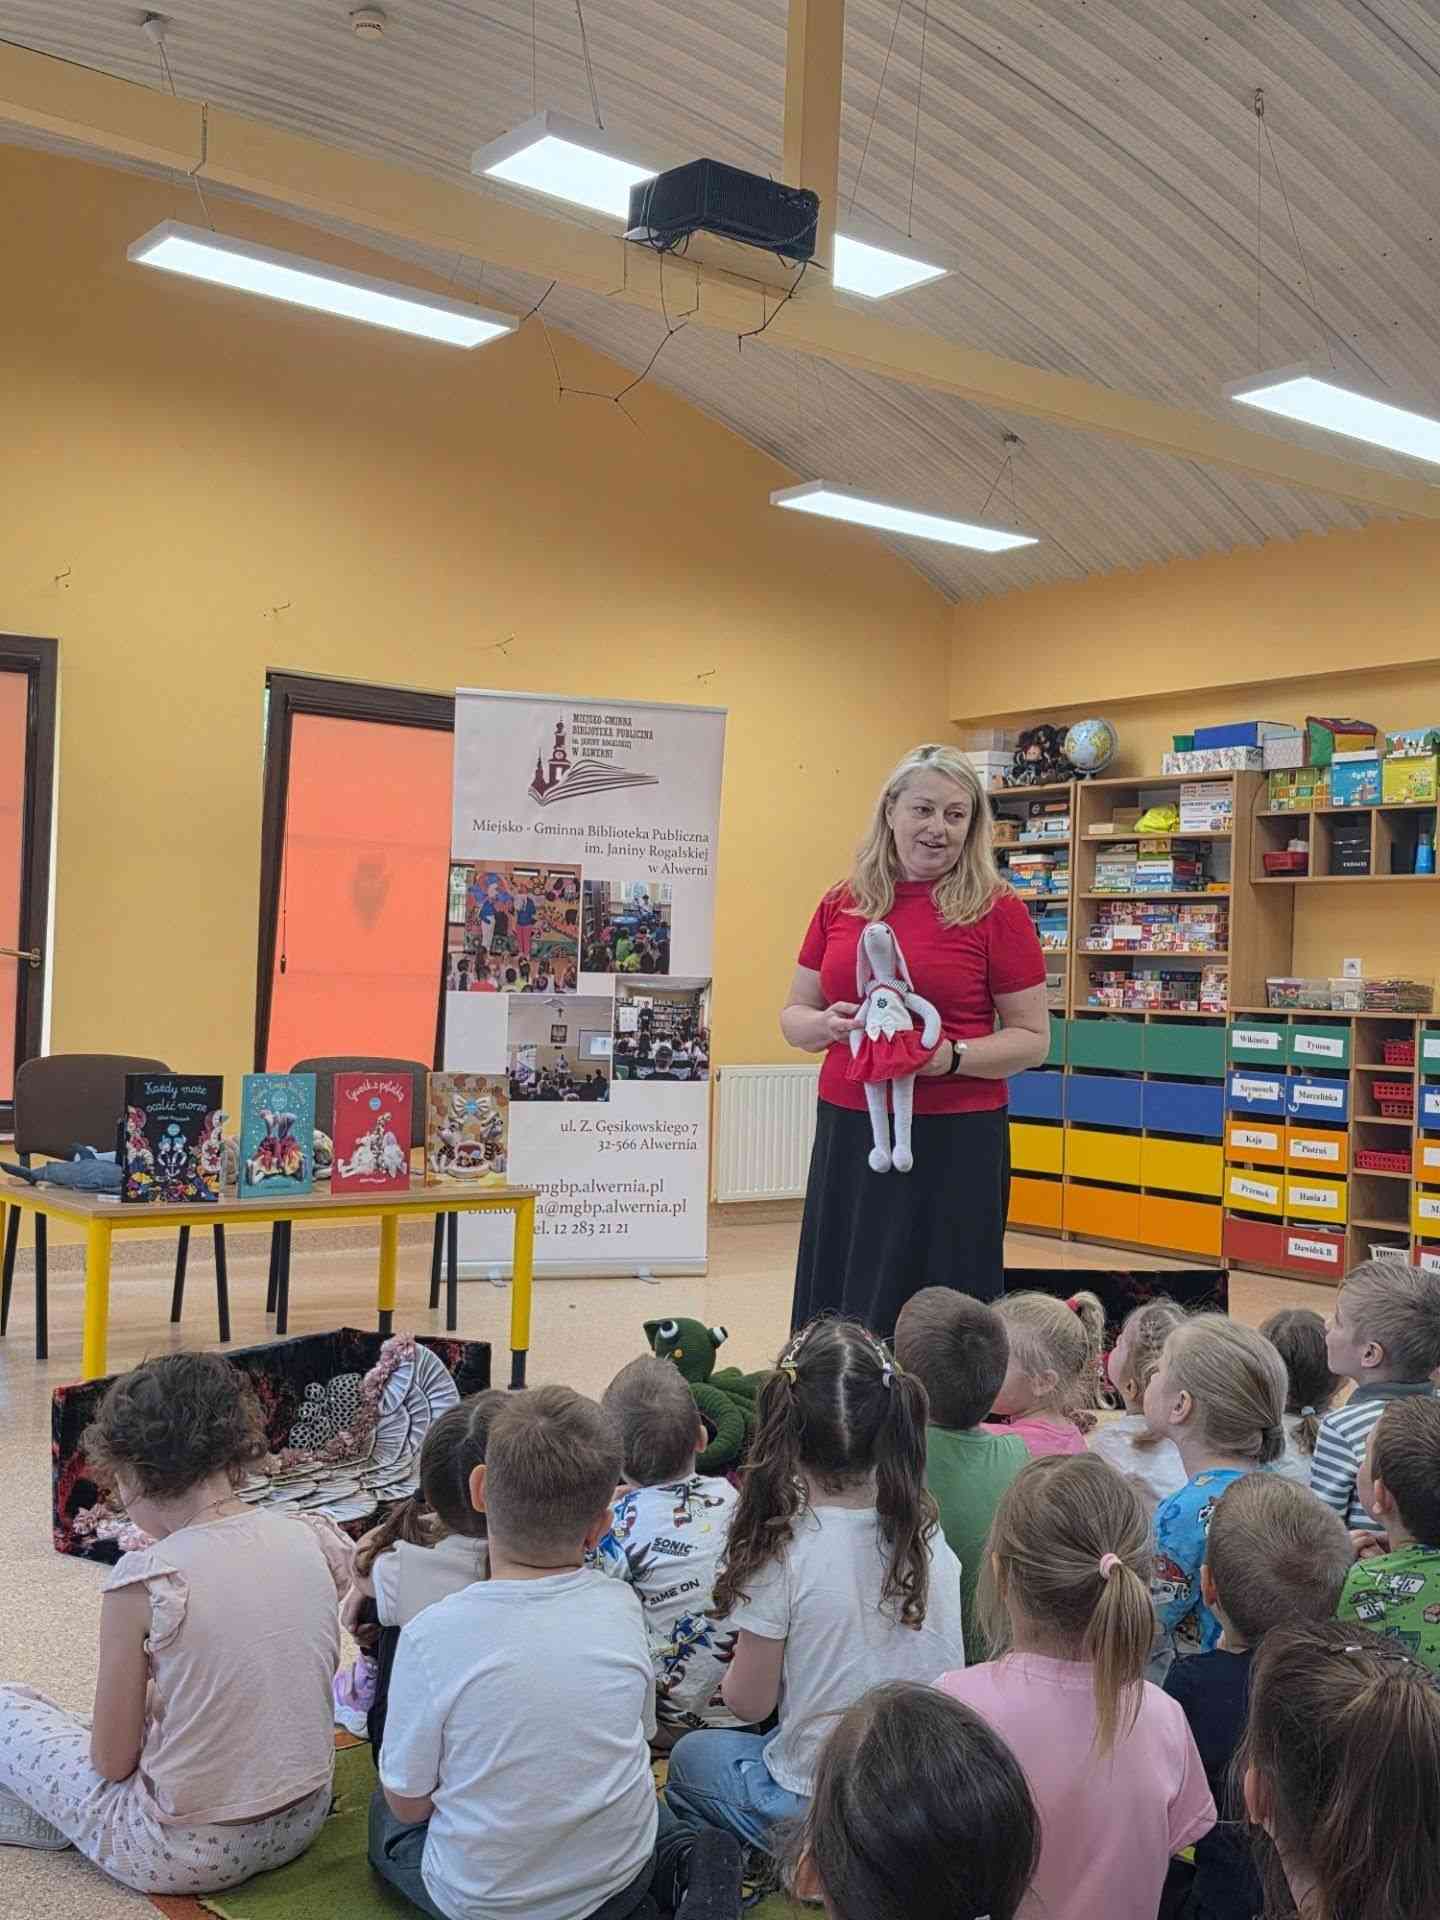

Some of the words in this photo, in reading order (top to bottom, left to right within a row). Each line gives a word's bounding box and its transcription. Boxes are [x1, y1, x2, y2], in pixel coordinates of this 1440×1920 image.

[572, 725, 613, 736] BIBLIOTEKA
[616, 728, 654, 740] PUBLICZNA
[472, 819, 523, 834] Miejsko
[534, 822, 584, 837] Gminna
[588, 825, 649, 840] Biblioteka
[652, 828, 709, 843] Publiczna
[584, 842, 604, 854] im.
[607, 843, 646, 858] Janiny
[649, 845, 708, 861] Rogalskiej
[648, 865, 660, 873] w
[660, 863, 708, 876] Alwerni
[560, 1120, 576, 1132] ul.
[579, 1120, 592, 1132] Z.
[691, 1124, 698, 1135] 7
[598, 1139, 637, 1152] 32-566
[640, 1138, 697, 1151] Alwernia
[516, 1179, 664, 1197] mgbp.alwernia.pl
[534, 1221, 549, 1235] el.
[554, 1224, 567, 1234] 12
[571, 1222, 594, 1236] 283
[600, 1224, 612, 1234] 21
[616, 1224, 628, 1234] 21
[652, 1537, 693, 1554] SONIC
[680, 1579, 700, 1593] ON
